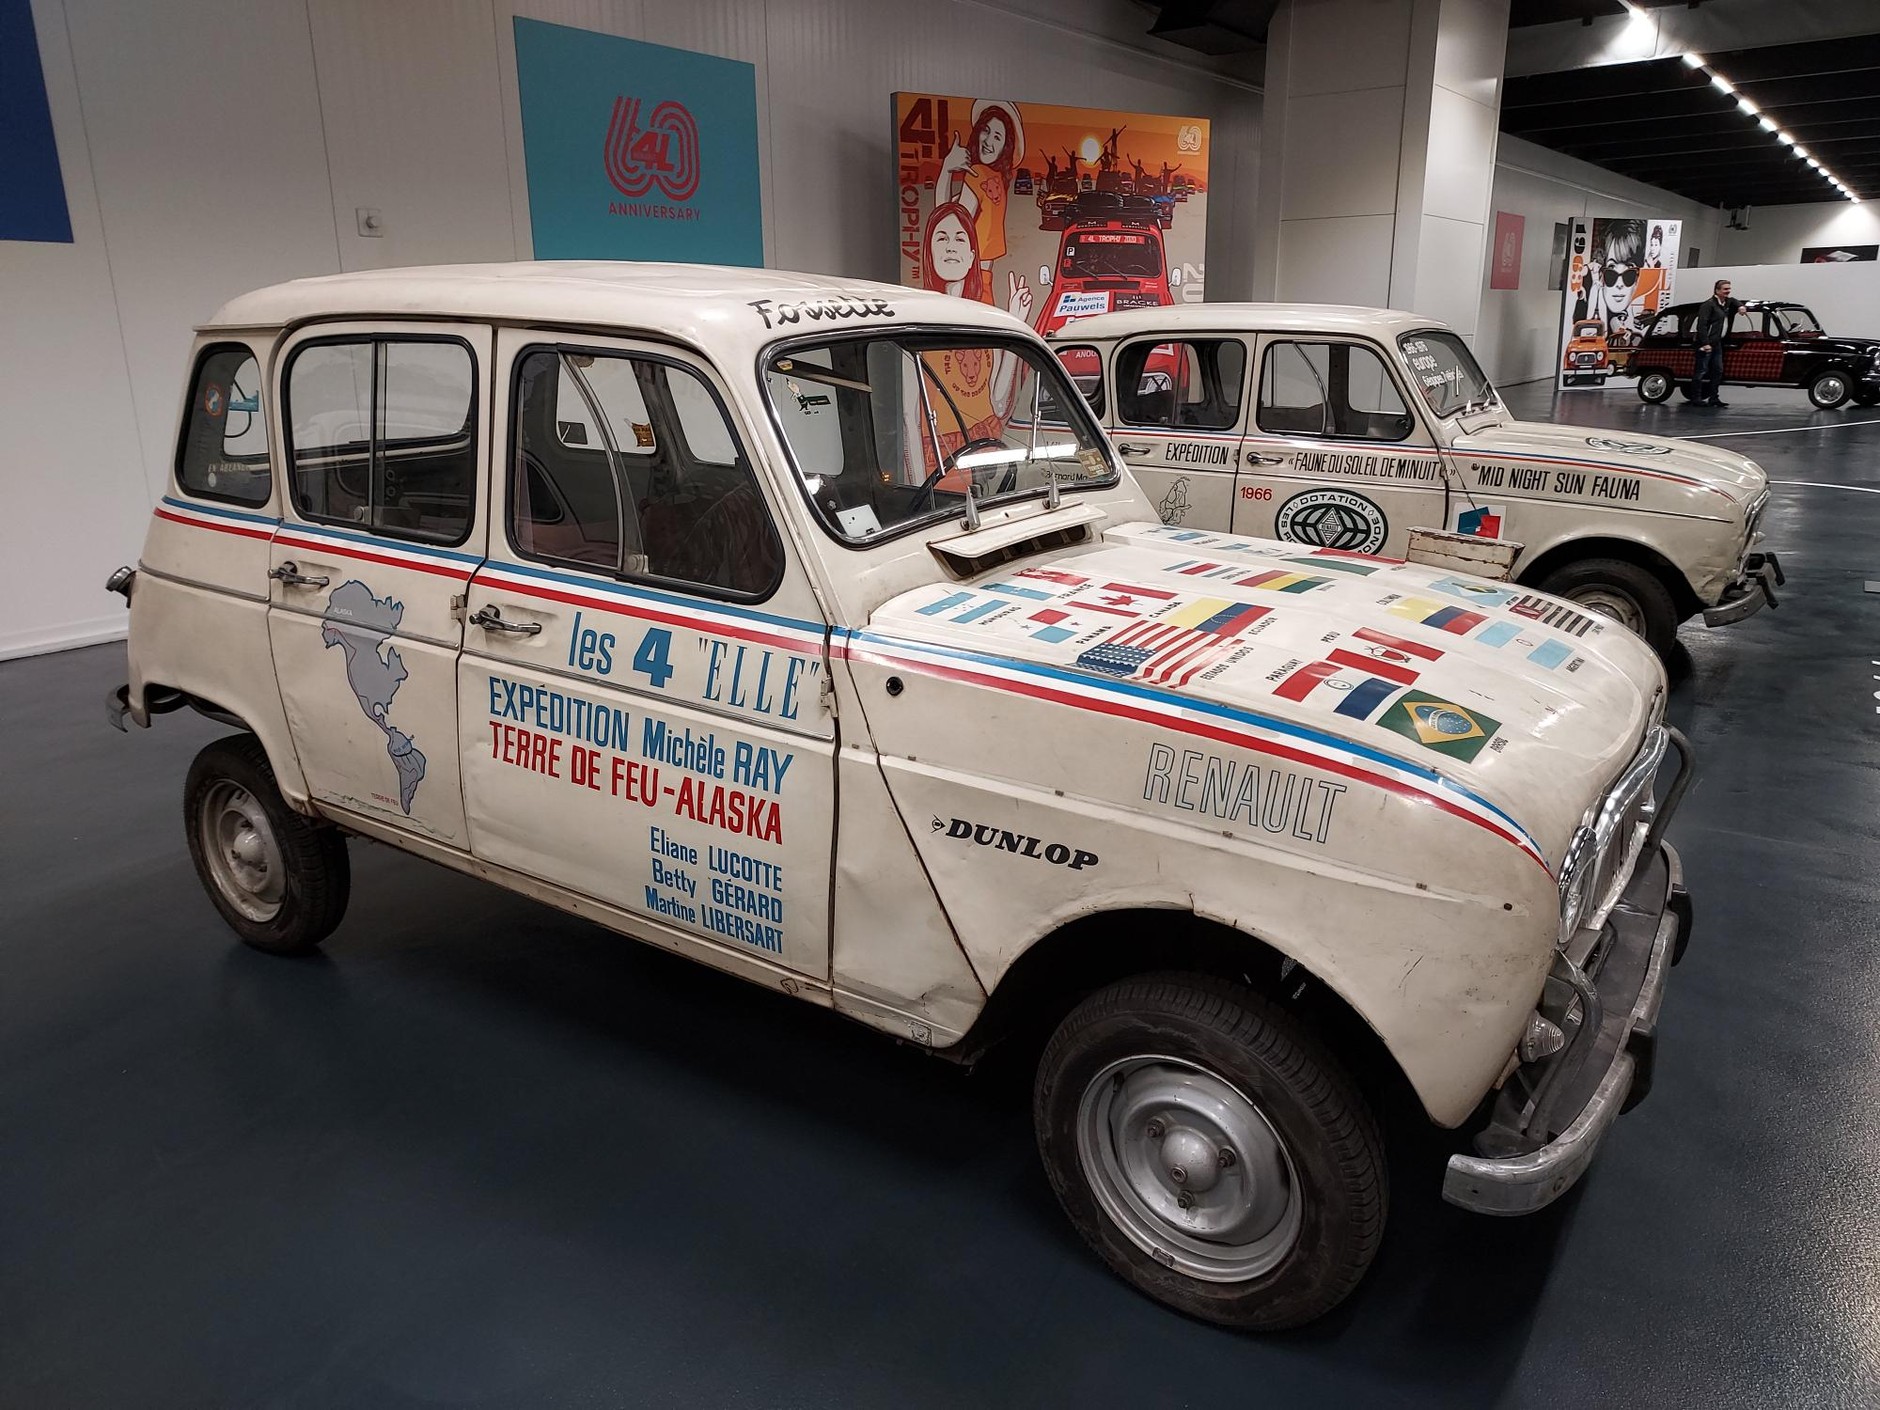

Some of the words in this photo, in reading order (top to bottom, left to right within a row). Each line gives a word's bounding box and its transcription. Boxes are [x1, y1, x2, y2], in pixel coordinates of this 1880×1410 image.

[630, 131, 675, 173] 4L
[608, 202, 701, 221] ANNIVERSARY
[1099, 235, 1120, 243] TROPHY
[1060, 303, 1105, 312] Pauwels
[1166, 442, 1229, 464] EXPÉDITION
[1328, 454, 1344, 474] DU
[1344, 455, 1378, 477] SOLEIL
[1379, 457, 1397, 478] DE
[1395, 458, 1440, 481] MINUIT
[1240, 487, 1273, 501] 1966
[1478, 465, 1505, 487] MID
[1508, 468, 1551, 492] NIGHT
[1554, 472, 1586, 495] SUN
[1591, 476, 1641, 501] FAUNA
[1299, 494, 1367, 512] DOTATION
[1281, 506, 1294, 528] LES
[1056, 583, 1095, 600] FRANCE
[978, 606, 1022, 626] HONDURAS
[1149, 601, 1183, 618] CANADA
[1075, 626, 1114, 645] PANAMA
[1248, 617, 1278, 636] ECUADOR
[568, 611, 616, 675] les
[632, 627, 674, 688] 4
[1199, 663, 1230, 681] ESTADOS
[1226, 646, 1254, 664] UNIDOS
[1265, 658, 1303, 682] PARAGUAY
[489, 675, 630, 752] EXPÉDITION
[643, 717, 725, 780] Michèle
[733, 741, 794, 795] RAY
[489, 720, 563, 779] TERRE
[571, 744, 601, 791] DE
[1142, 742, 1348, 844] RENAULT
[945, 817, 1100, 871] DUNLOP
[650, 826, 698, 865] Eliane
[708, 845, 782, 892] LUCOTTE
[652, 857, 696, 898] Betty
[712, 878, 783, 924] GÉRARD
[645, 885, 696, 924] Martine
[701, 904, 784, 954] LIBERSART
